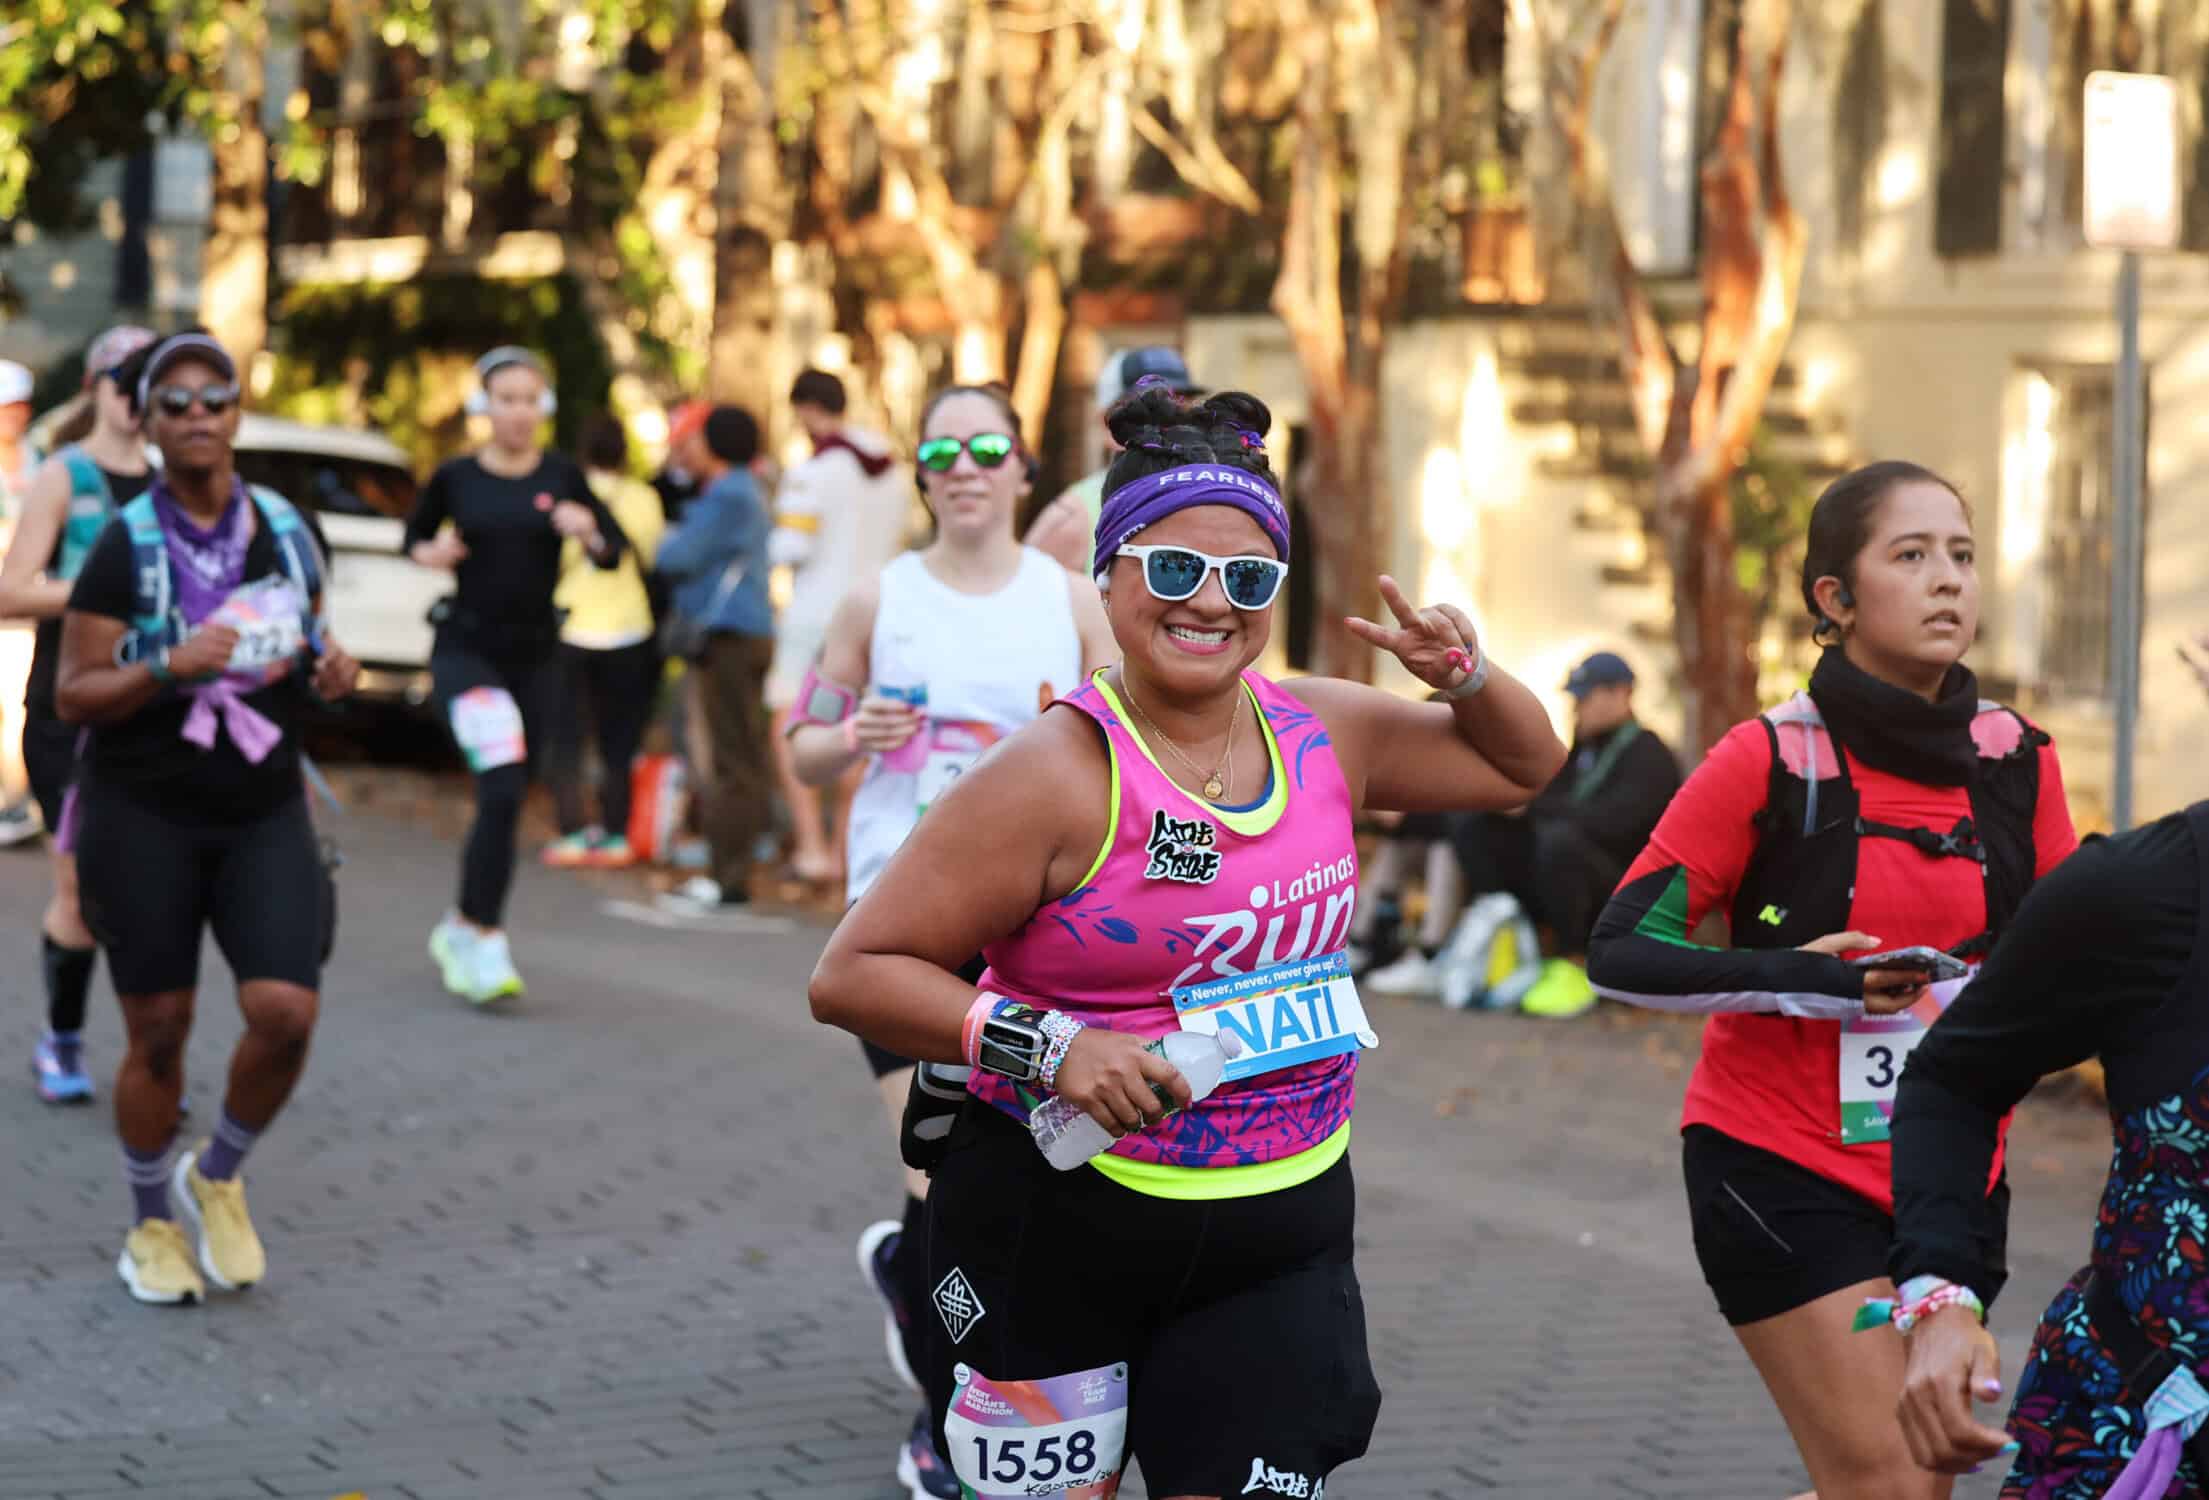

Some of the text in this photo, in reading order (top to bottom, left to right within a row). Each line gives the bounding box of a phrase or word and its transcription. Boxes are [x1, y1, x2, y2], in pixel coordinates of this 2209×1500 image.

[1273, 853, 1355, 908] Latinas
[1191, 957, 1336, 1001] Never, never, never give up!
[1214, 985, 1341, 1054] NATI
[973, 1430, 1097, 1483] 1558
